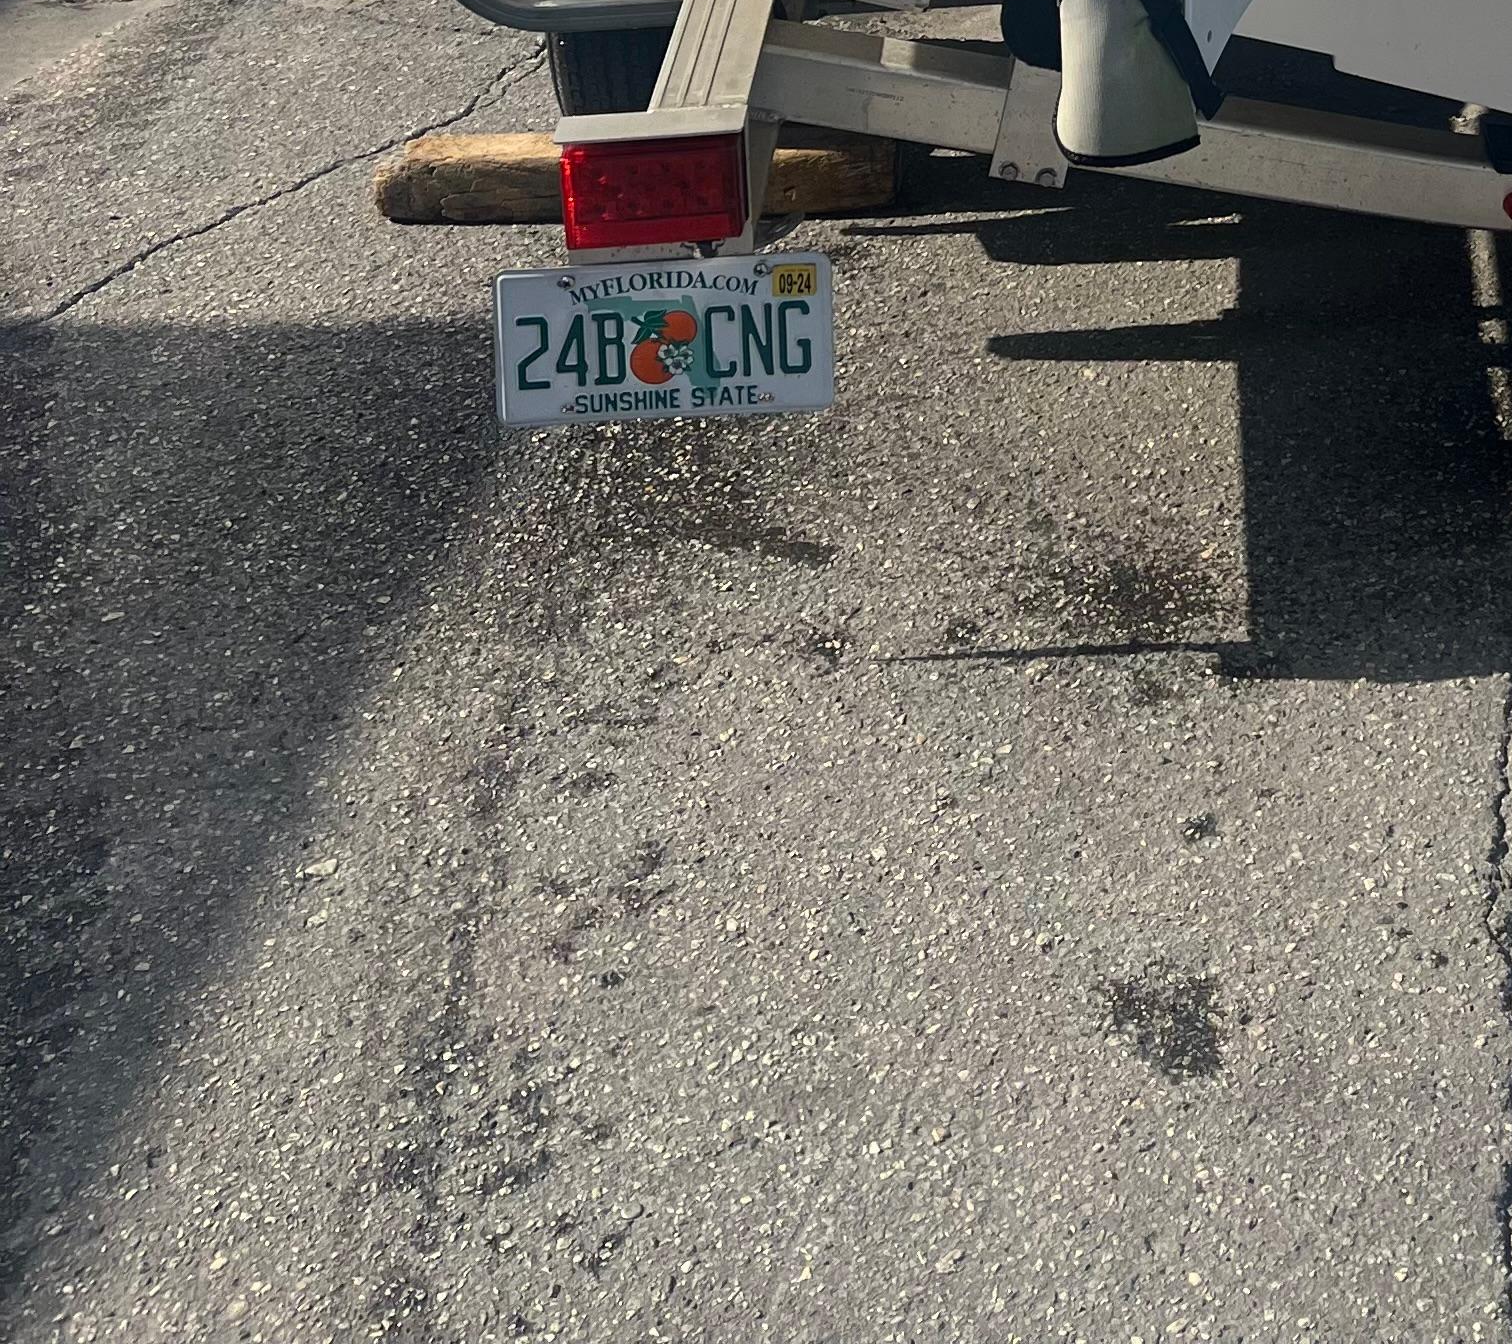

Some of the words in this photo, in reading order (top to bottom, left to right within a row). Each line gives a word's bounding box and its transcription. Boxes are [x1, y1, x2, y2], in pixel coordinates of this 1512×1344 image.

[568, 270, 759, 306] MYFLORIDA.COM
[779, 273, 811, 294] 09-24
[516, 312, 627, 391] 24B
[704, 300, 812, 379] CNG
[576, 388, 681, 414] SUNSHINE
[692, 384, 758, 408] STATE
